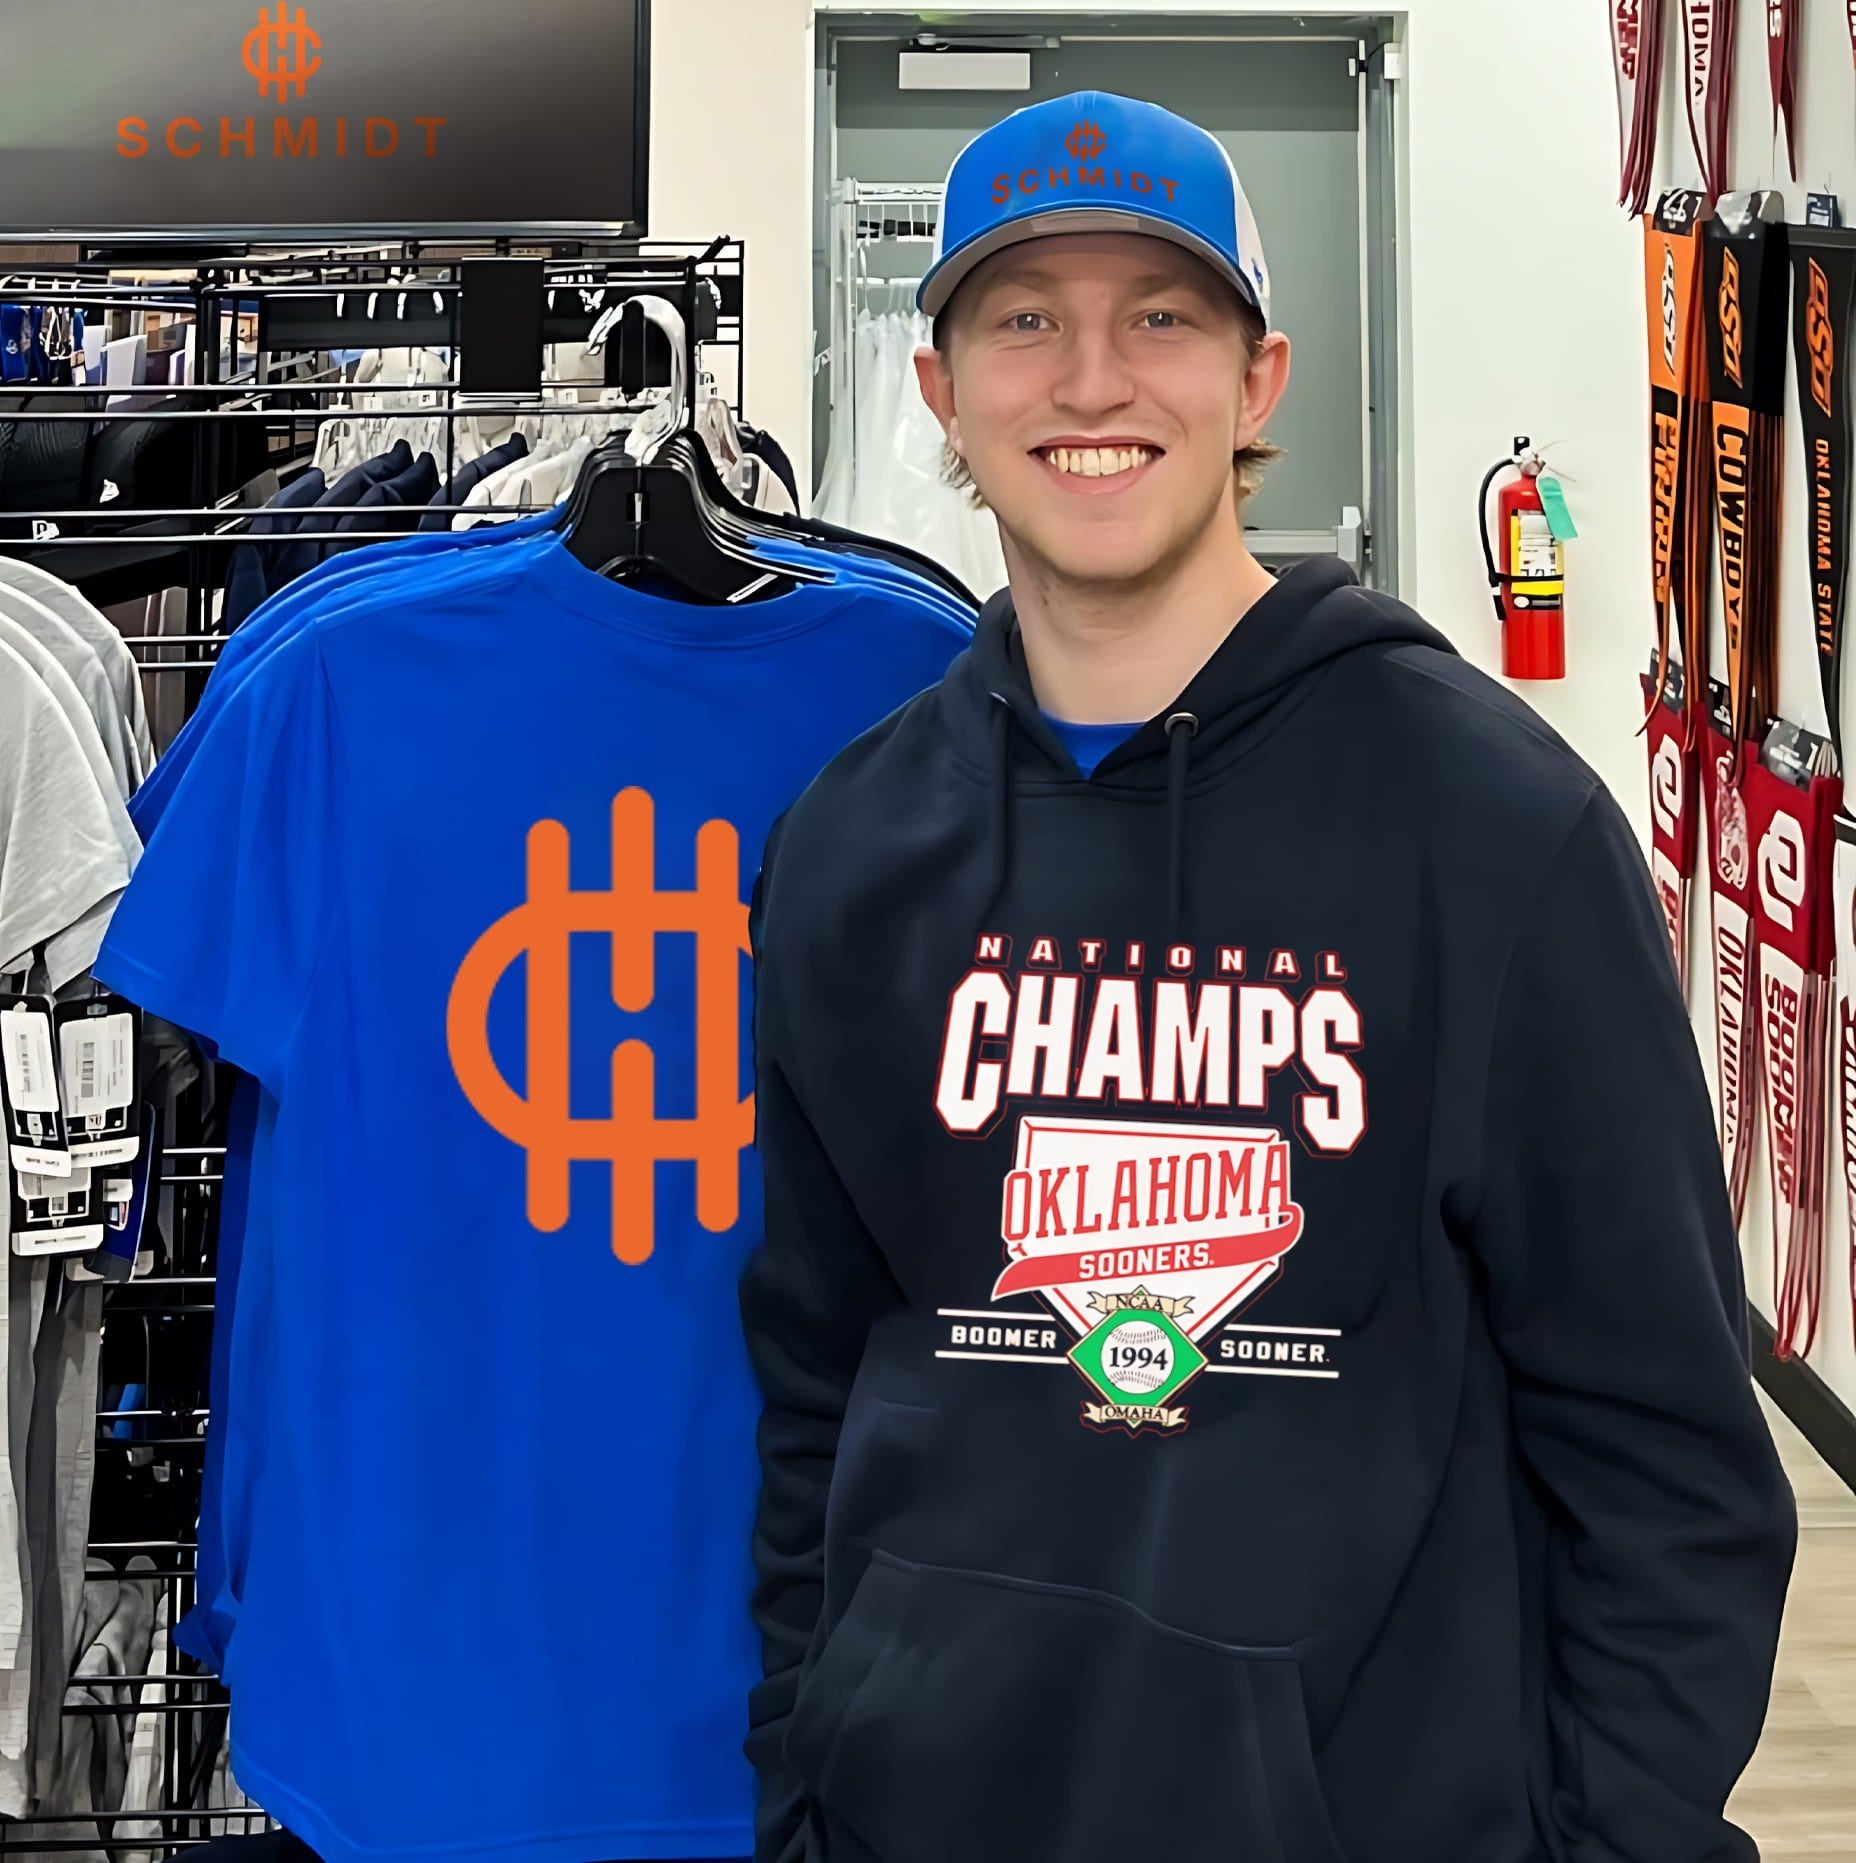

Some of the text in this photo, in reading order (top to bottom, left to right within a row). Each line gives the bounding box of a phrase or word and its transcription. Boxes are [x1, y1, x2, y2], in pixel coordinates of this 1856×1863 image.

[116, 116, 447, 159] SCHMIDT
[991, 166, 1179, 204] SCHMIDT
[1815, 438, 1833, 571] OKLAHOMA
[978, 935, 1345, 977] NATIONAL
[1718, 925, 1745, 1144] OKLAHOMA
[935, 970, 1367, 1151] CHAMPS
[1003, 1143, 1291, 1241] OKLAHOMA
[1116, 1294, 1164, 1310] NCAA
[951, 1324, 1057, 1349] BOOMER
[1109, 1346, 1168, 1371] 1994
[1105, 1406, 1164, 1420] OMAHA
